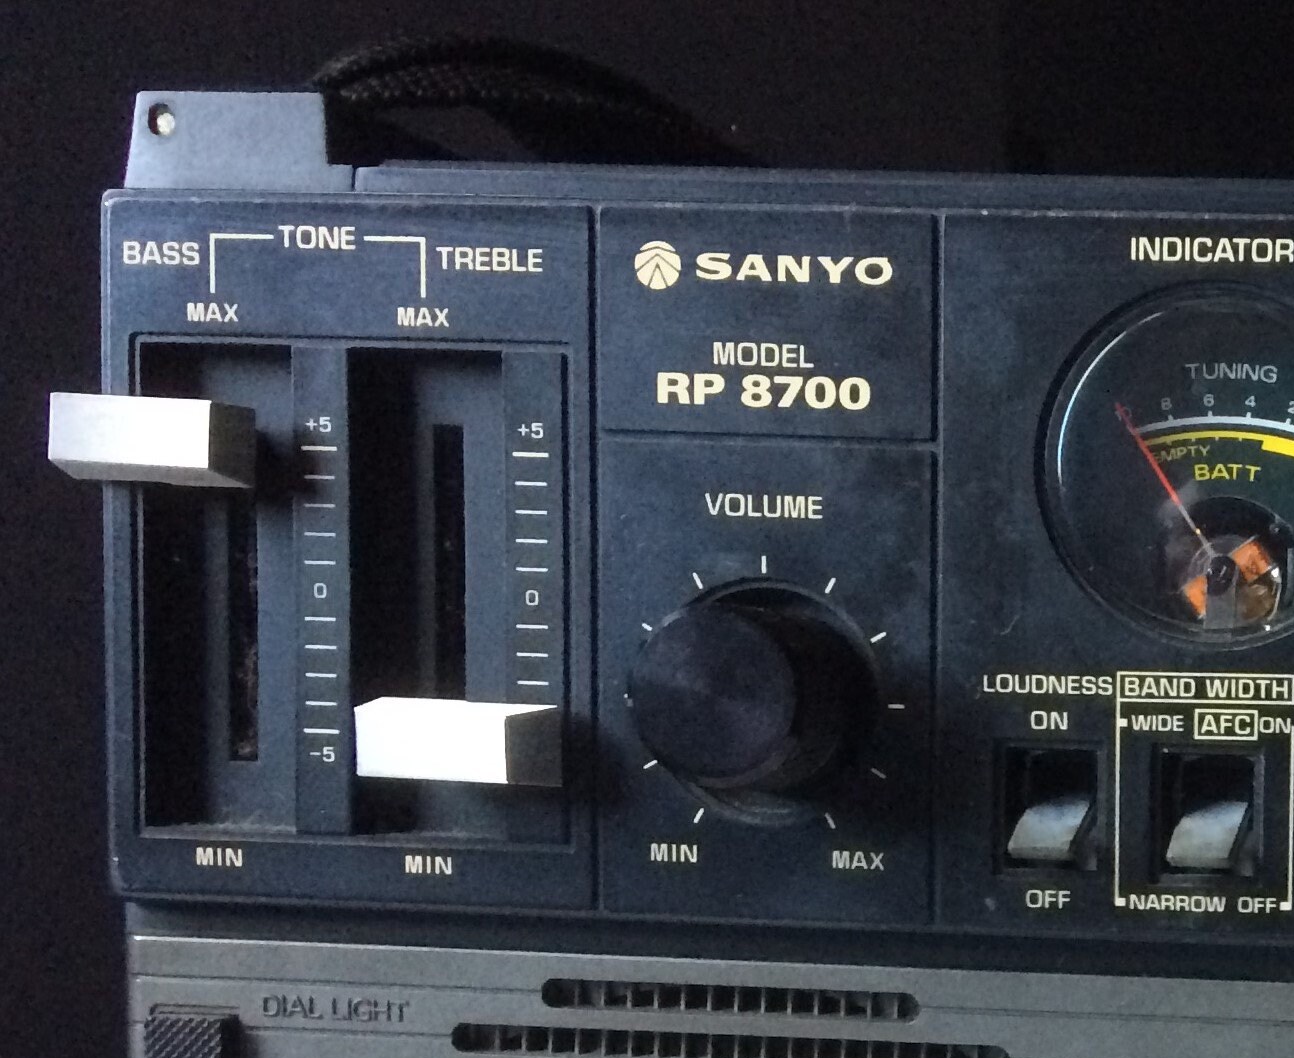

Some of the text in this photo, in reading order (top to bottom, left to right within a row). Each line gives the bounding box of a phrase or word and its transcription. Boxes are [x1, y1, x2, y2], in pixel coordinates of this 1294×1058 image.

[278, 225, 356, 250] TONE
[123, 241, 200, 265] BASS
[436, 246, 543, 272] TREBLE
[1130, 236, 1294, 263] INDICATOR
[696, 252, 893, 285] SANYO
[187, 303, 239, 322] MAX
[397, 307, 449, 327] MAX
[713, 342, 814, 368] MODEL
[1186, 362, 1278, 384] TUNING
[657, 372, 871, 410] RP 8700
[1203, 393, 1215, 408] 6
[1160, 397, 1172, 411] 8
[1244, 395, 1256, 408] 4
[304, 417, 332, 433] +5
[517, 423, 544, 439] +5
[1194, 463, 1262, 482] BATT
[705, 492, 823, 519] VOLUME
[313, 583, 328, 599] 0
[525, 590, 539, 606] 0
[983, 674, 1113, 696] LOUDNESS
[1124, 677, 1289, 699] BAND WIDTH
[1030, 711, 1068, 731] ON
[1131, 714, 1184, 733] WIDE
[1201, 716, 1252, 735] AFC
[1259, 716, 1292, 734] ON
[309, 746, 335, 762] -5
[196, 848, 243, 867] MIN
[650, 843, 698, 863] MIN
[832, 850, 885, 871] MAX
[404, 856, 453, 875] MIN
[1025, 890, 1071, 910] OFF
[1129, 895, 1277, 915] NARROW OFF
[262, 994, 409, 1022] DIAL LIGHT
